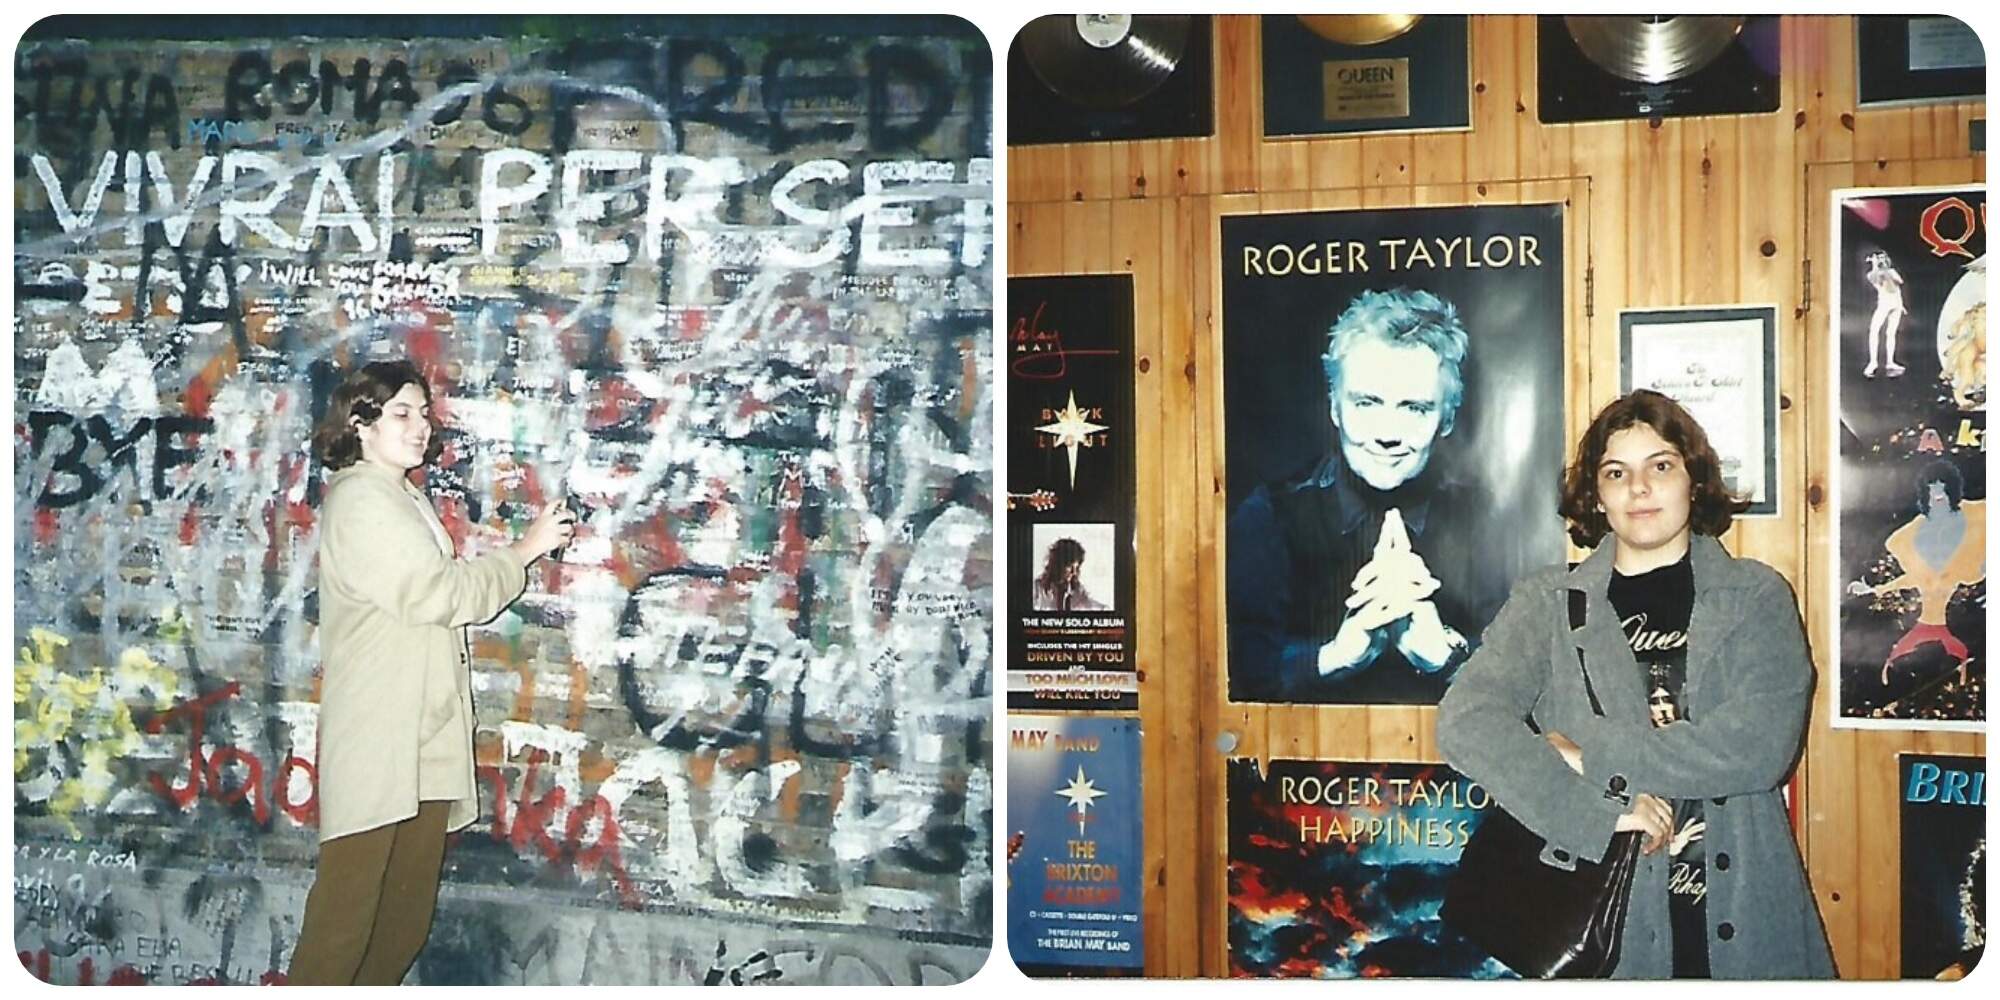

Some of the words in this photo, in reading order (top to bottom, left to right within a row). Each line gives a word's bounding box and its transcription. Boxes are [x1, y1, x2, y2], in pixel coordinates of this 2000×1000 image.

[1337, 65, 1395, 84] QUEEN
[30, 148, 397, 264] VIVRAI
[480, 146, 748, 267] PER
[1243, 241, 1369, 277] ROGER
[1379, 235, 1542, 271] TAYLOR
[1022, 617, 1039, 628] THE
[1041, 617, 1064, 628] NEW
[1065, 617, 1091, 628] SOLO
[1092, 617, 1125, 628] ALBUM
[1026, 651, 1073, 663] DRIVEN
[1076, 652, 1093, 663] BY
[1096, 652, 1125, 663] YOU
[1024, 673, 1053, 685] TOO
[1034, 689, 1063, 700] WILL
[1064, 689, 1091, 700] KILL
[1094, 689, 1121, 700] YOU
[1011, 729, 1048, 752] MAY
[1281, 776, 1382, 807] ROGER
[1389, 779, 1503, 810] TAYLO
[1907, 762, 1986, 806] BRI
[1299, 815, 1469, 848] HAPPINESS
[1067, 839, 1096, 860] THE
[86, 848, 138, 874] ROSA
[1045, 862, 1118, 883] BRIXTON
[1053, 938, 1083, 949] BRIAN
[1084, 939, 1106, 950] MAY
[1107, 941, 1131, 952] BAND
